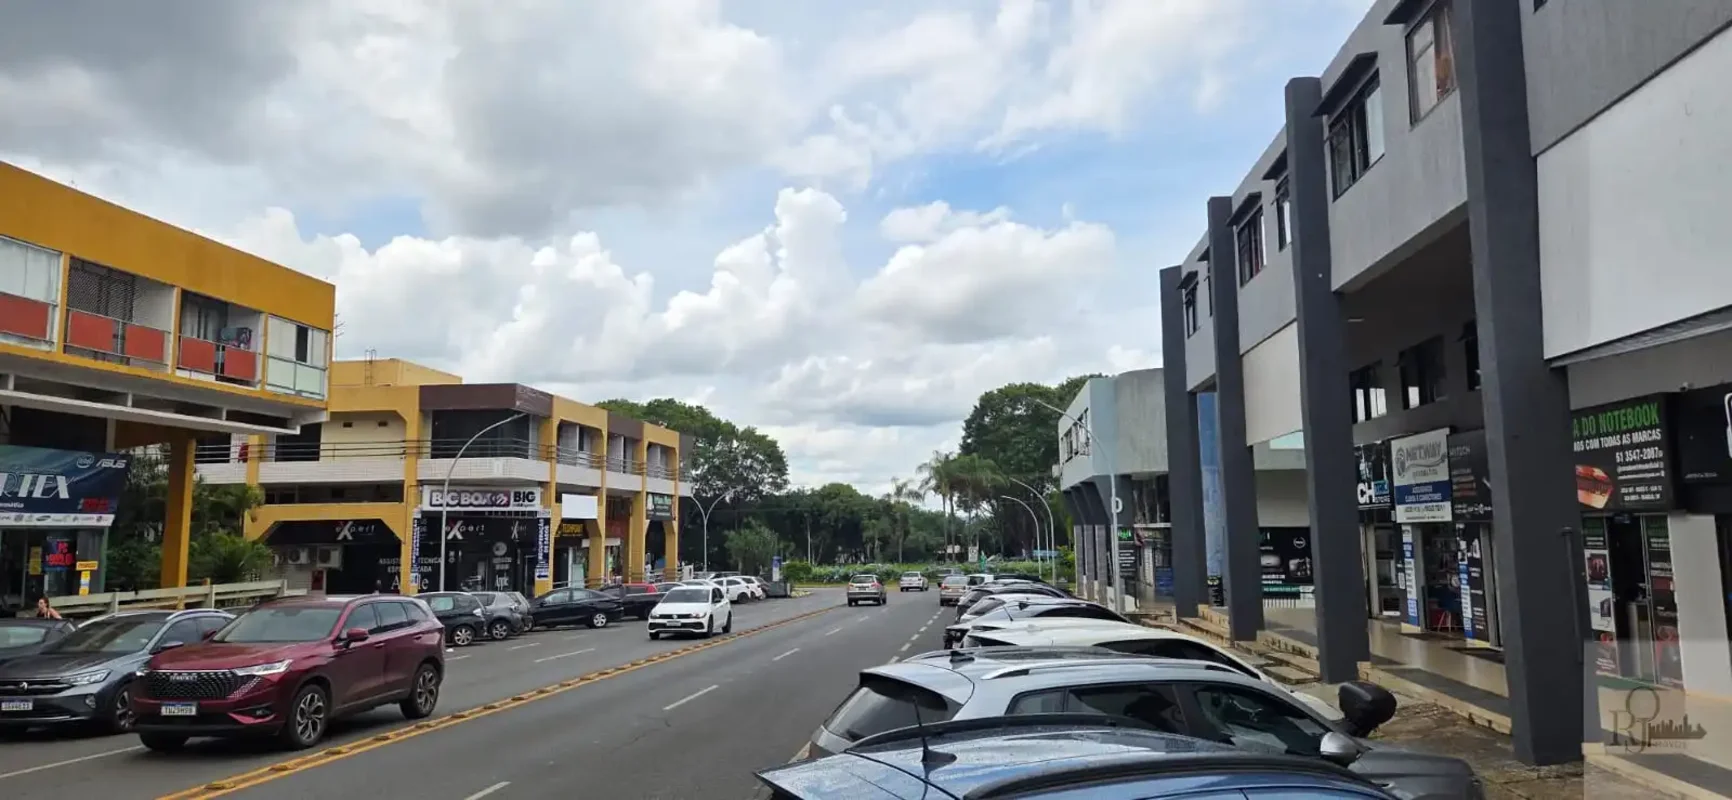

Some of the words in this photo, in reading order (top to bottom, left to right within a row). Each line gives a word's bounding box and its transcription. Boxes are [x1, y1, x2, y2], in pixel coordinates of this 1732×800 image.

[1582, 415, 1596, 434] DO
[1599, 402, 1660, 433] NOTEBOOK
[1586, 436, 1600, 450] COM
[1601, 434, 1621, 448] TODAS
[1622, 433, 1631, 445] AS
[1632, 428, 1662, 444] MARCAS
[95, 458, 127, 469] ASUS
[513, 491, 536, 503] BIG
[1357, 481, 1375, 504] CH
[390, 574, 429, 590] Ale
